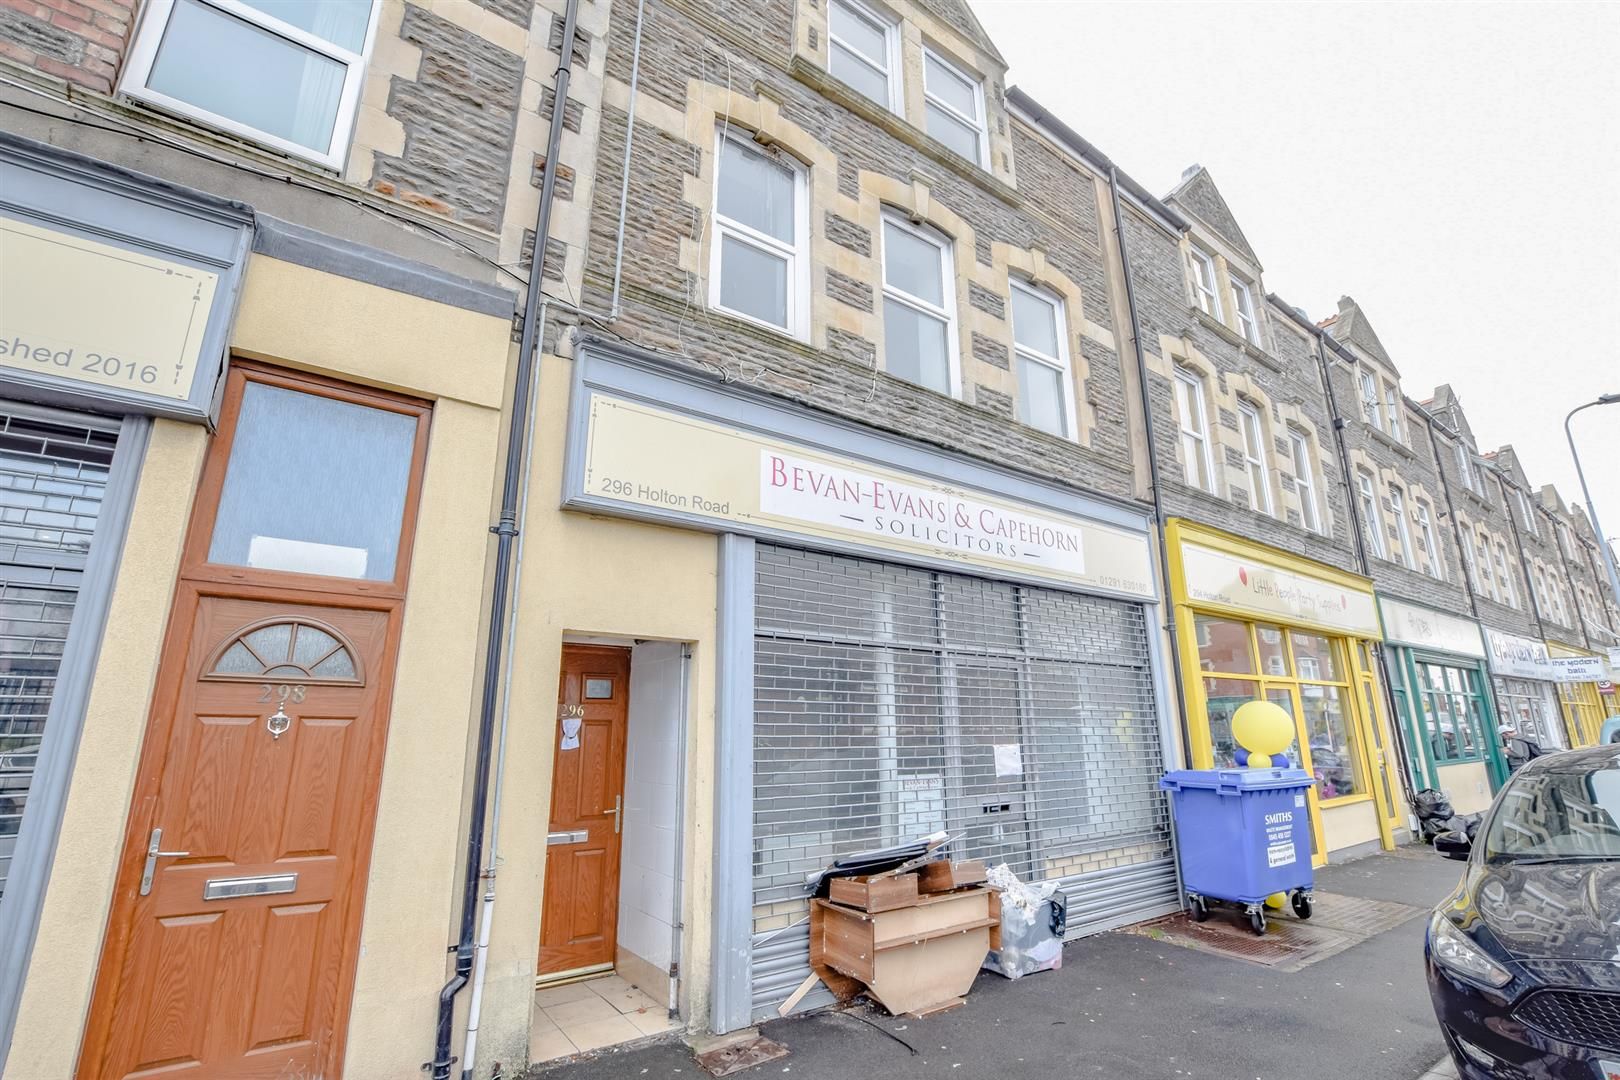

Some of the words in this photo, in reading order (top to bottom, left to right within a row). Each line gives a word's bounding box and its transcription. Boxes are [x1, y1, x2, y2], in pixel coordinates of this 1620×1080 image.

[82, 353, 158, 384] 2016
[601, 478, 632, 497] 296
[638, 484, 687, 507] Holton
[692, 497, 730, 515] Road
[770, 456, 947, 523] BEVAN-EVANS
[954, 503, 973, 530] &
[979, 509, 1079, 552] CAPEHORN
[875, 516, 1017, 558] SOLICITORS
[1252, 577, 1273, 597] Little
[257, 684, 307, 703] 298
[561, 704, 584, 716] 296
[1265, 811, 1293, 825] SMITHS
